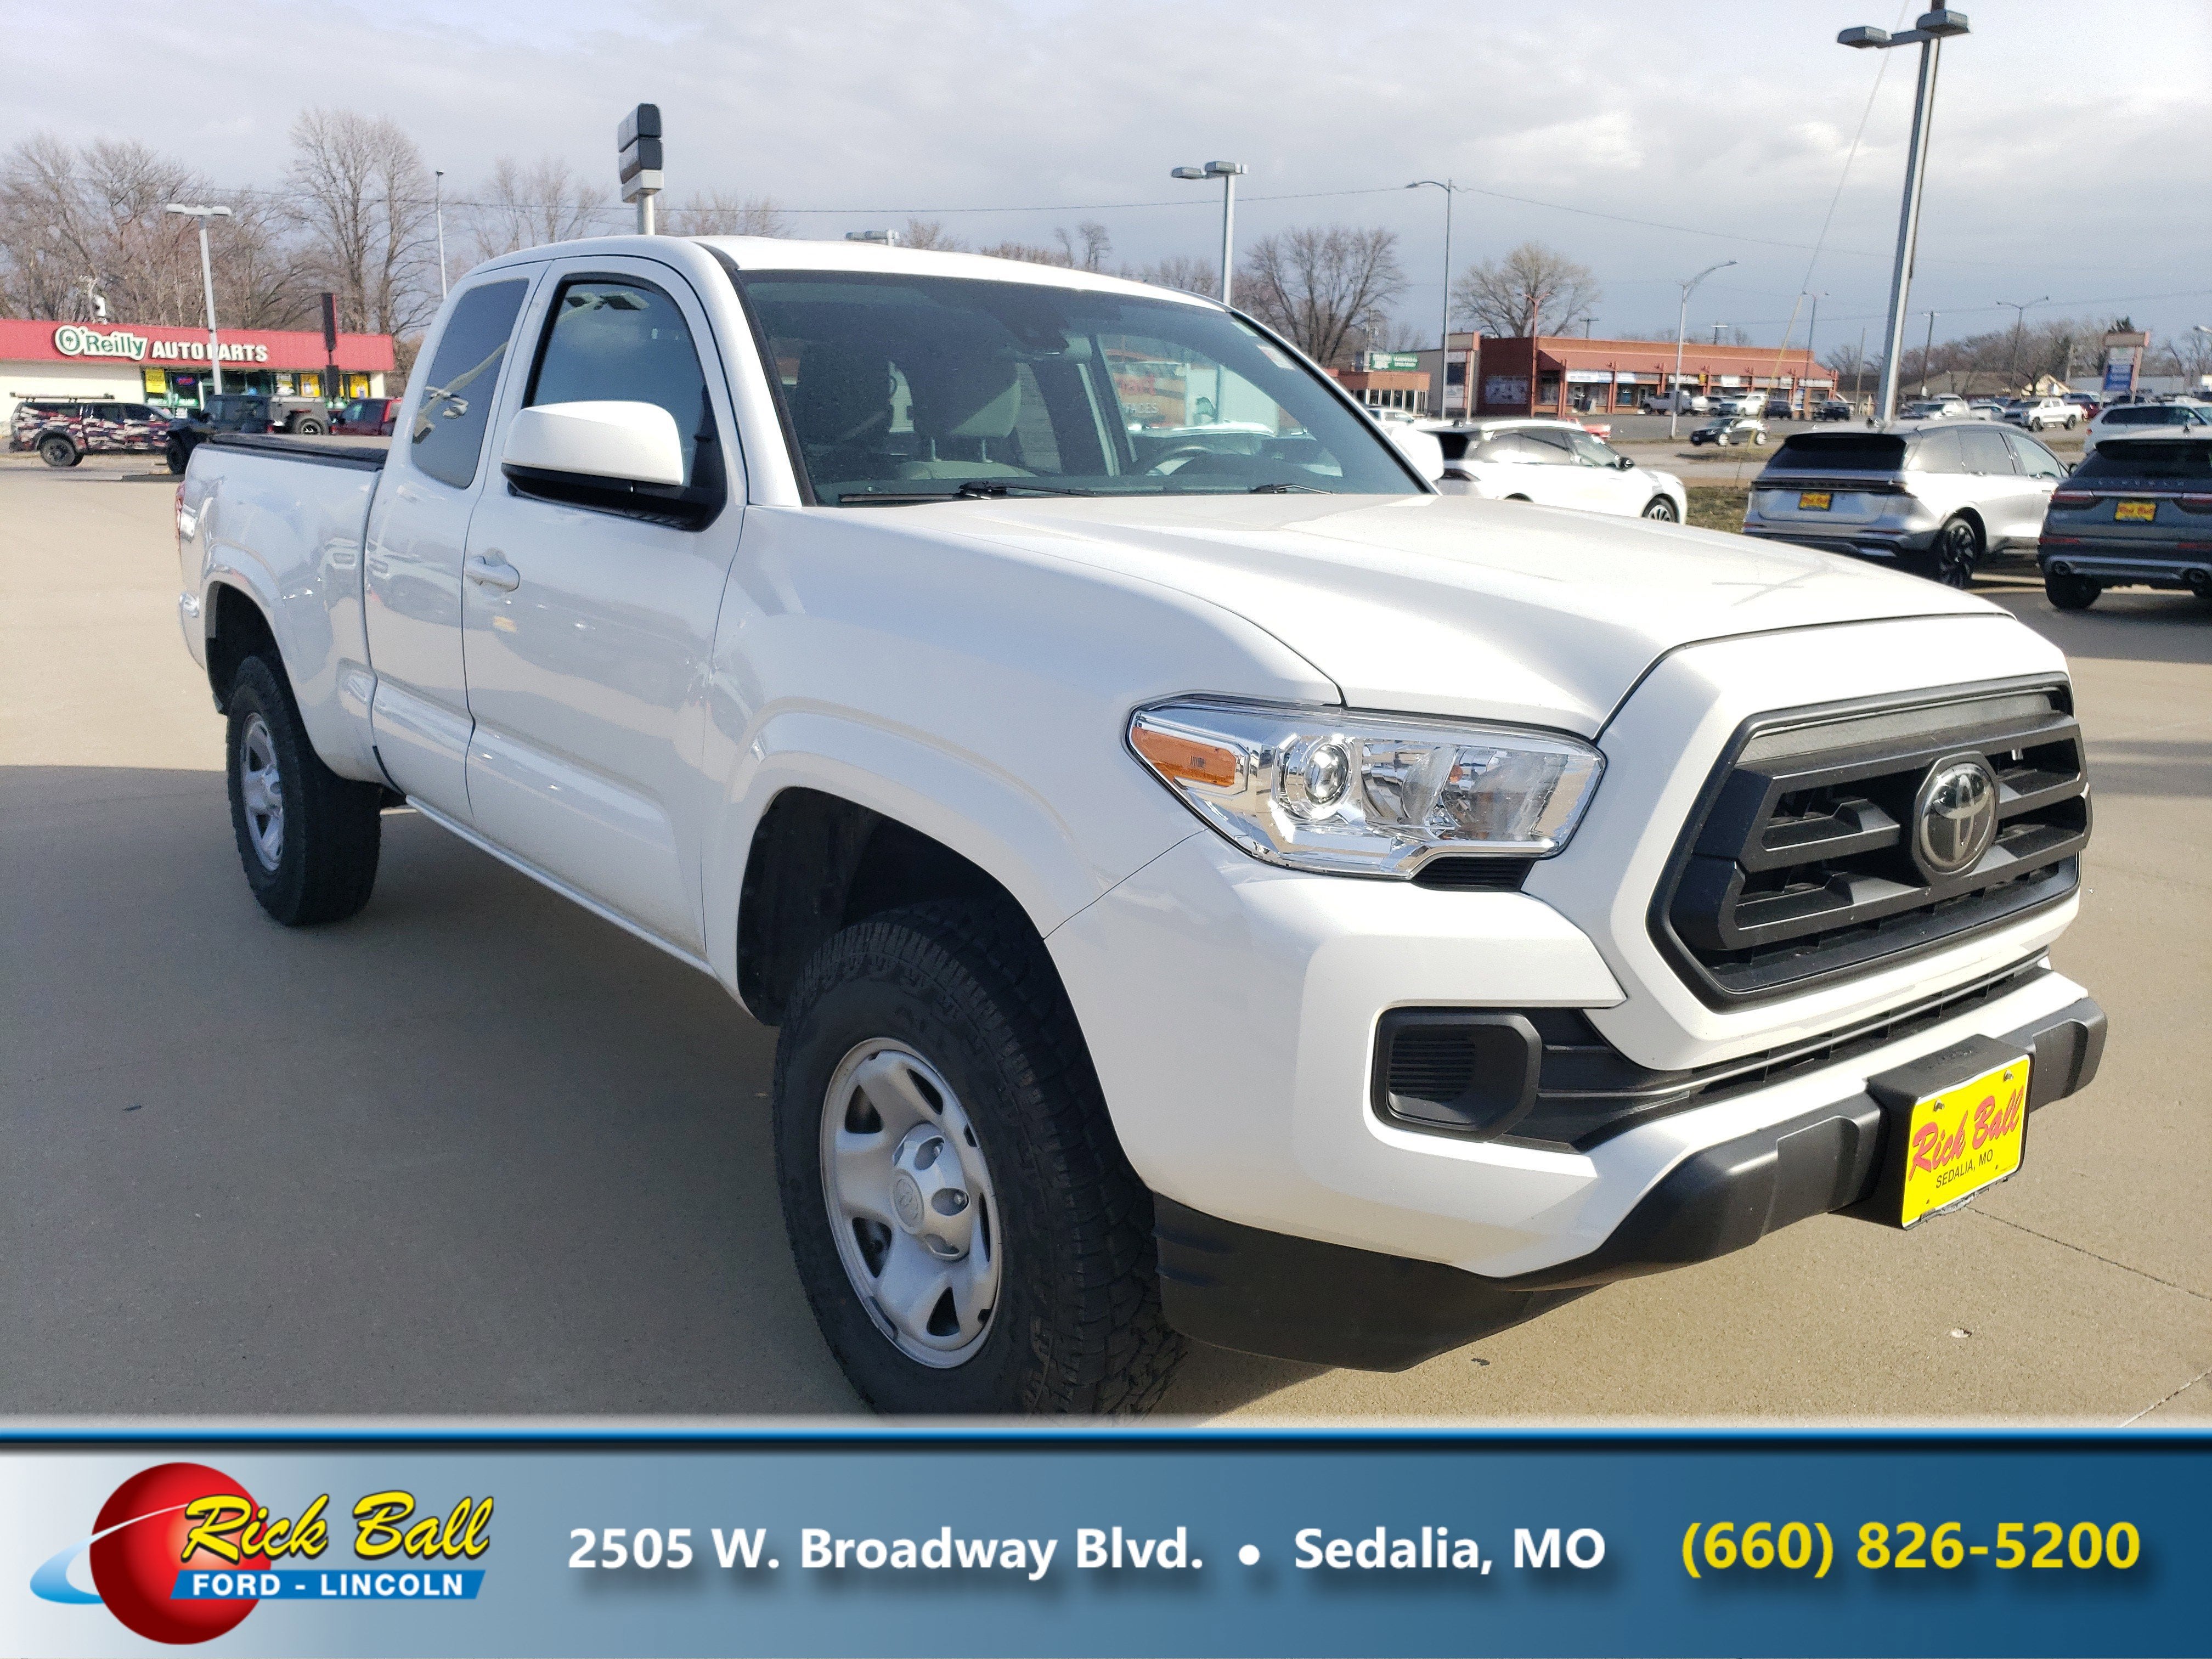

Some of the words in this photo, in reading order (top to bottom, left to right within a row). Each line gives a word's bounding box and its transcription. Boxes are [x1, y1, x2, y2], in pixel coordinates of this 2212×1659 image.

[58, 328, 144, 357] O'Reilly
[151, 341, 204, 360] AUTO
[1909, 1109, 1968, 1182] Rick
[1972, 1085, 2024, 1150] Ball
[1936, 1158, 1976, 1189] SEDALIA,
[1978, 1149, 1993, 1167] MO
